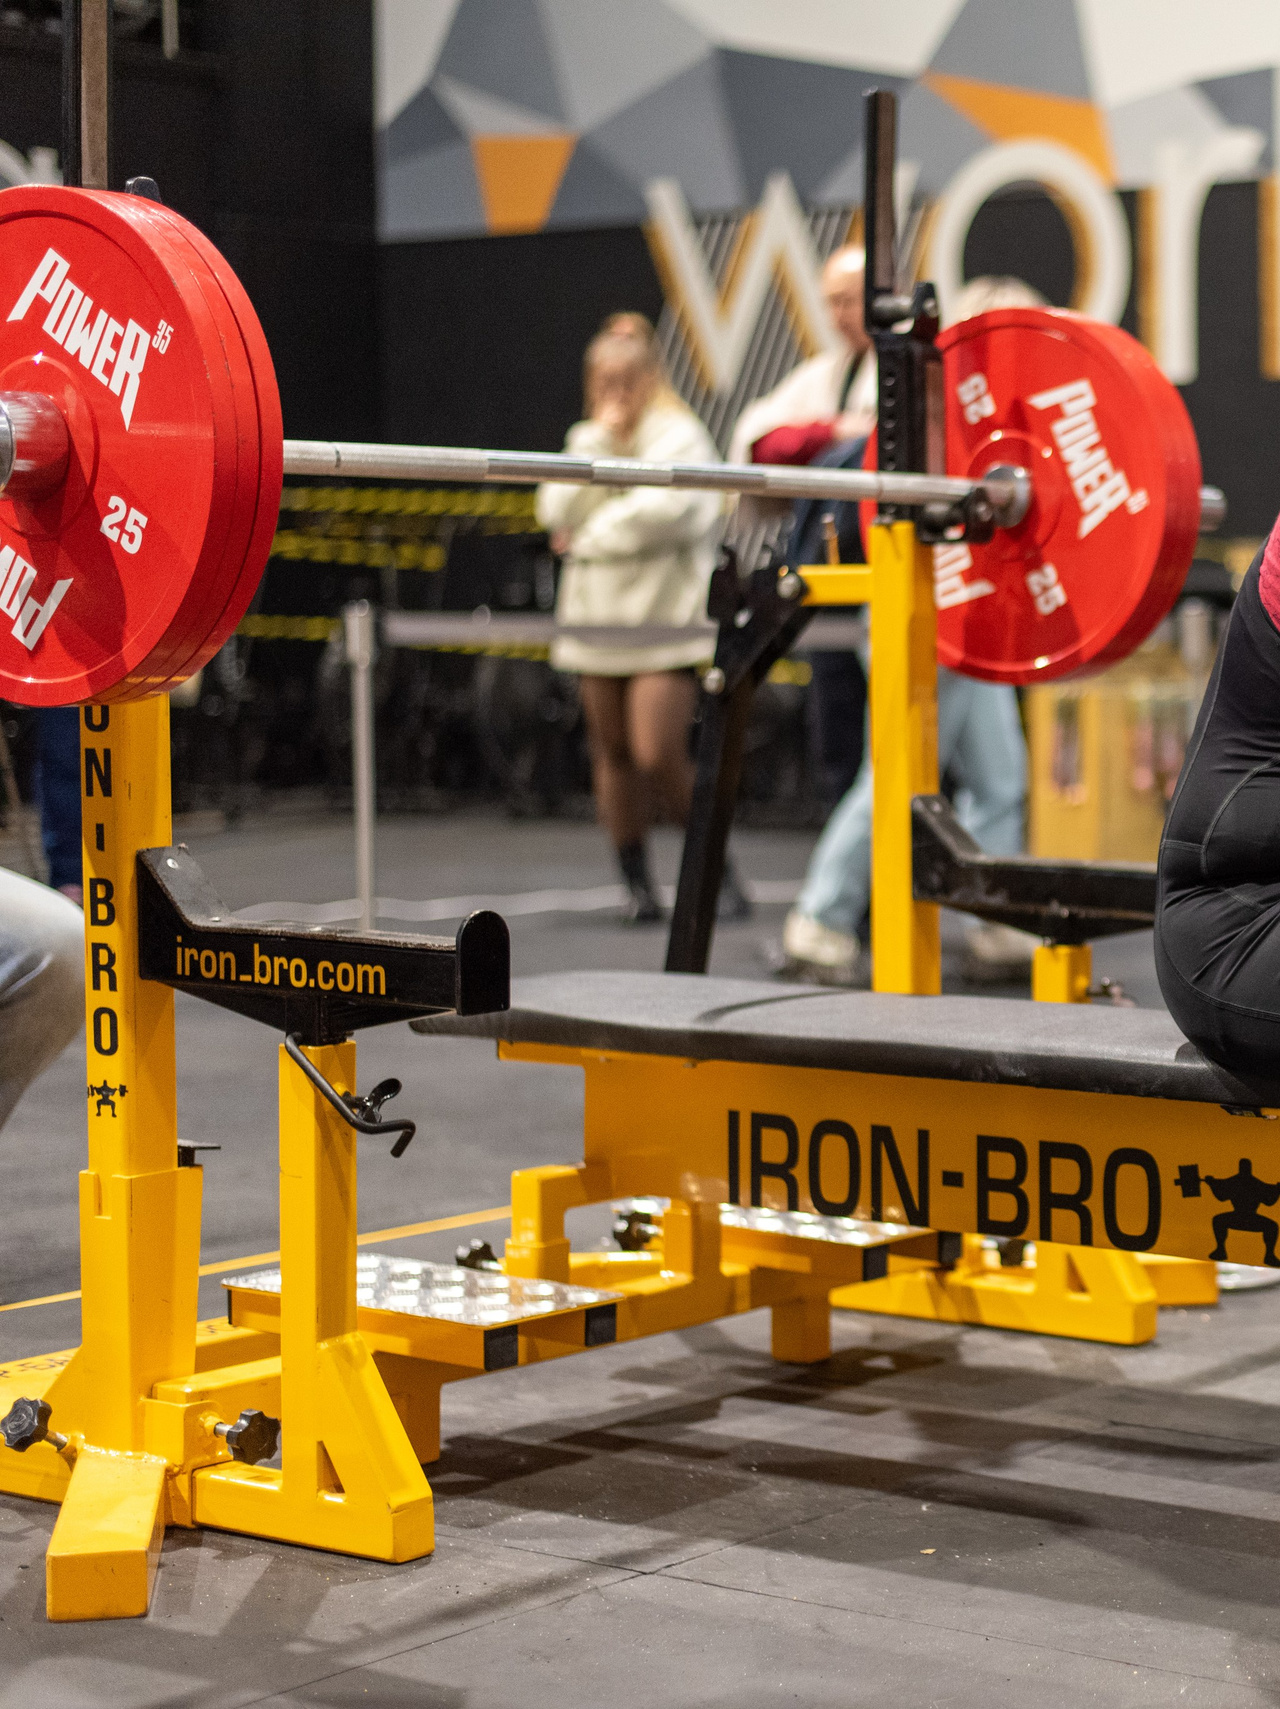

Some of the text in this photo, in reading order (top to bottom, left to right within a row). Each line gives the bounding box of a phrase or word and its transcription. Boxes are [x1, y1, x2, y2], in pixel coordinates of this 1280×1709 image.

[6, 247, 174, 431] POWER 35
[1026, 378, 1130, 540] POWER
[99, 495, 148, 555] 25
[1025, 563, 1068, 616] 25
[176, 935, 387, 996] iron_bro.com
[727, 1110, 1162, 1252] IRON-BRO
